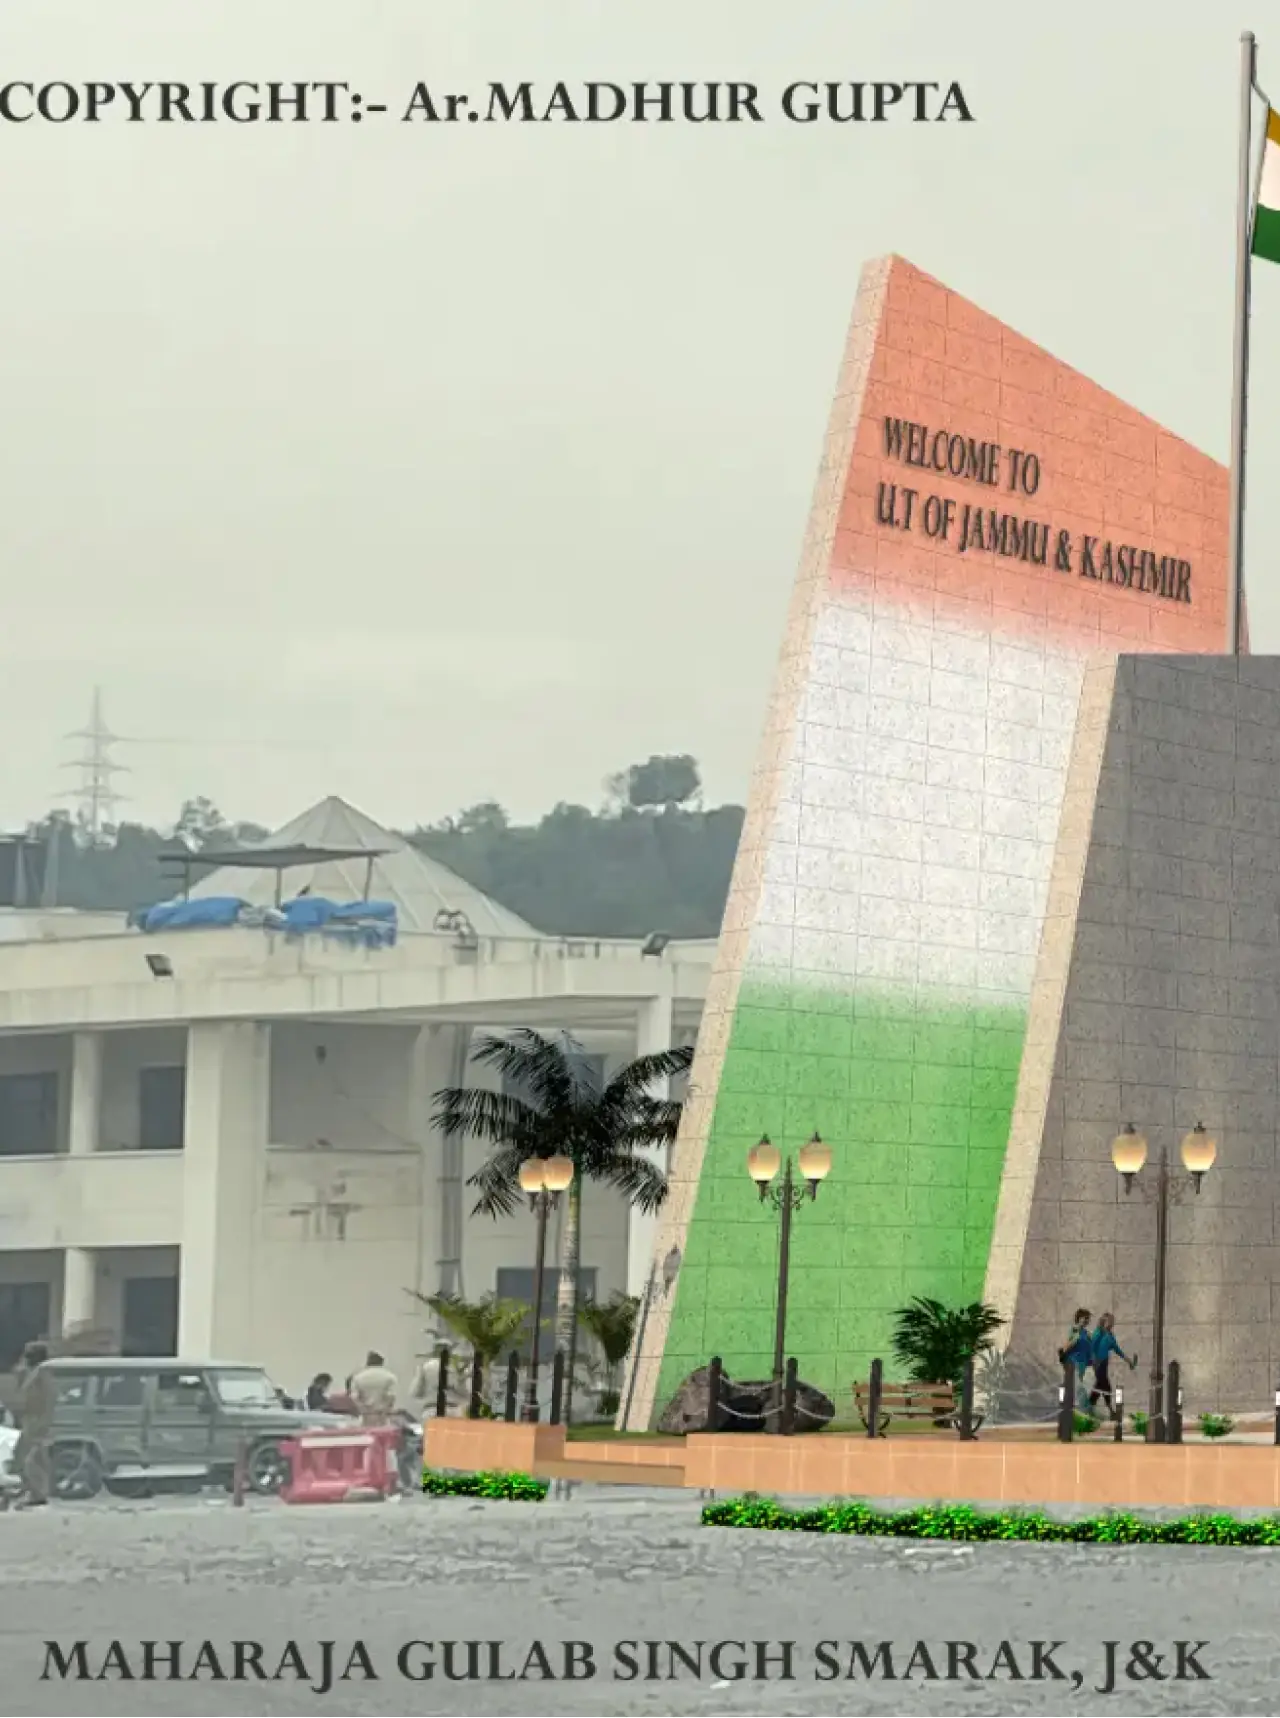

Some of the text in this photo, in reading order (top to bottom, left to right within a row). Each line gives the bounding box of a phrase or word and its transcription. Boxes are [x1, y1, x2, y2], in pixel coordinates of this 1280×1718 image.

[884, 416, 1040, 495] WELCOME TO
[877, 481, 1192, 603] U.T OF JAMMU & KASHMIR
